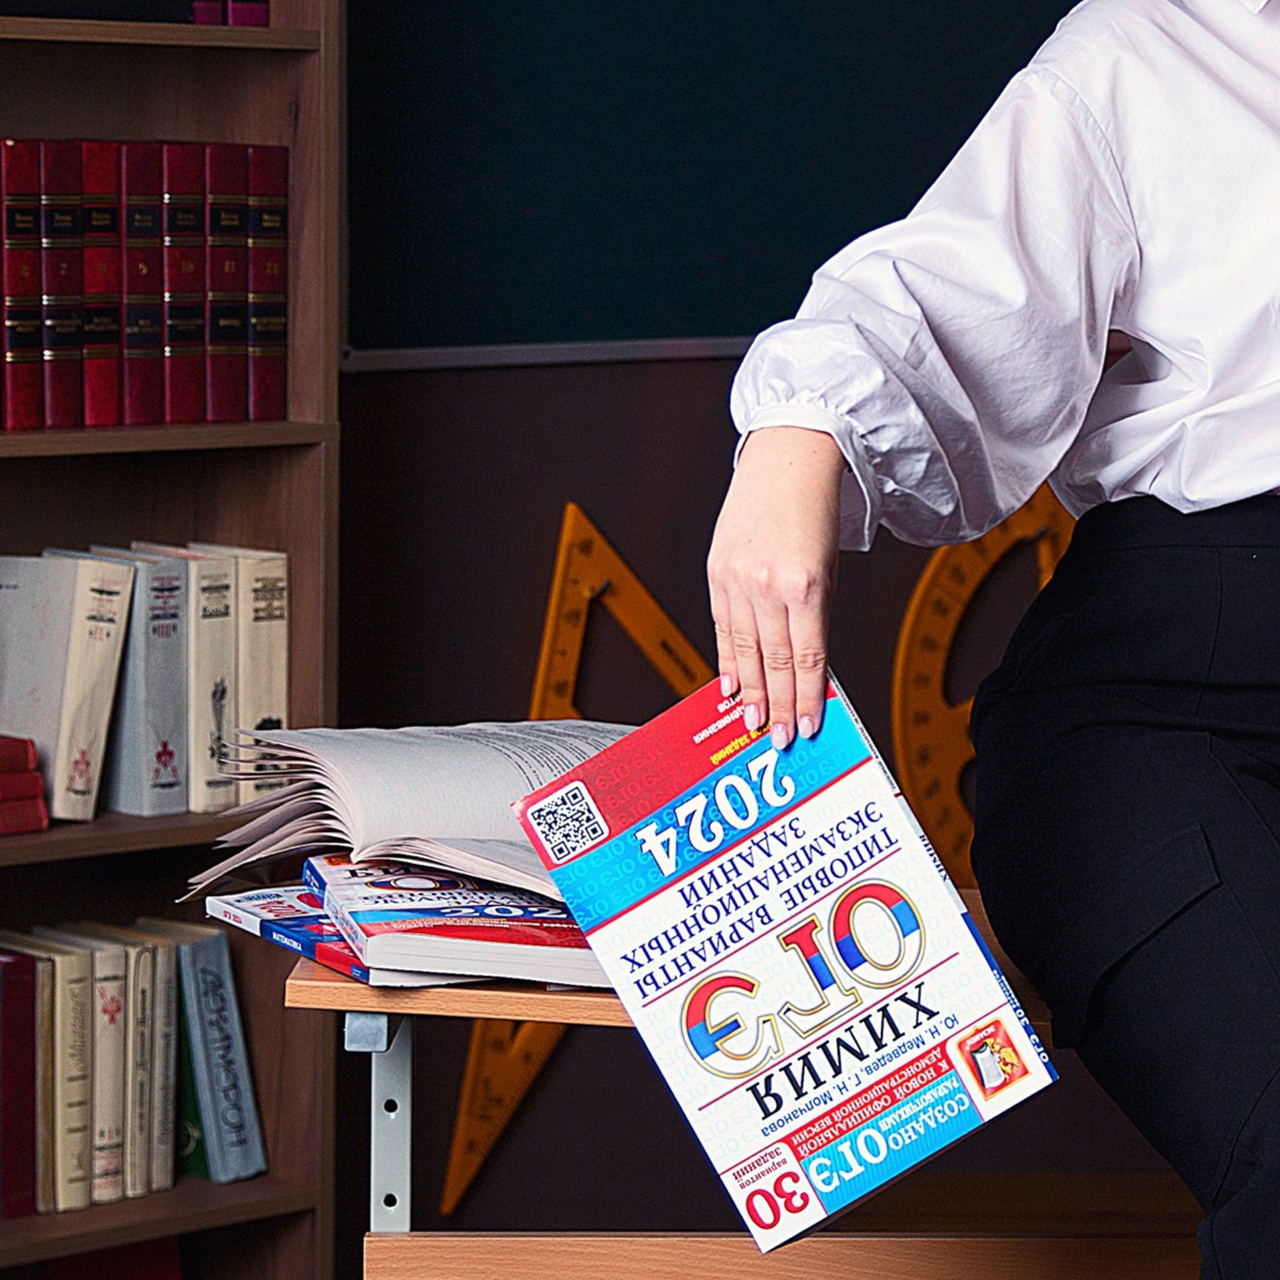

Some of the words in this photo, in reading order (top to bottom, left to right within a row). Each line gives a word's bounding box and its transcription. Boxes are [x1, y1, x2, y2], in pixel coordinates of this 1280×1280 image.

[690, 704, 747, 743] ценивания
[715, 690, 745, 713] етов
[707, 732, 752, 765] заданий
[629, 746, 803, 880] 2024
[673, 814, 810, 910] ЗАДАНИЙ
[778, 824, 898, 911] ТИПОВЫЕ
[619, 799, 883, 973] ЭКЗАМЕНАЦИОННЫХ
[439, 905, 570, 919] 202
[631, 903, 775, 999] ВАРИАНТЫ
[657, 863, 947, 1096] ОГЭ
[924, 1024, 940, 1041] Н.
[939, 1013, 959, 1031] Ю.
[744, 981, 940, 1120] ХИМИЯ
[859, 1033, 925, 1078] Медведев,
[937, 1059, 949, 1071] К
[1028, 1032, 1050, 1064] ОГЭ
[831, 1046, 942, 1121] ДЕМОНСТРАЦИОННОЙ
[832, 1080, 849, 1097] Н.
[847, 1072, 861, 1087] Г.
[892, 1066, 938, 1100] НОВОЙ
[759, 1089, 834, 1139] Молчанова
[796, 1092, 892, 1158] ОФИЦИАЛЬНОЙ
[875, 1076, 960, 1132] РАЗРАБОТЧИКАМИ
[883, 1089, 972, 1151] СОЗДАНО
[789, 1115, 831, 1143] ВЕРСИИ
[731, 1146, 783, 1182] заданий
[737, 1155, 788, 1189] вариантов
[803, 1123, 893, 1196] ОГЭ
[739, 1167, 814, 1234] 30
